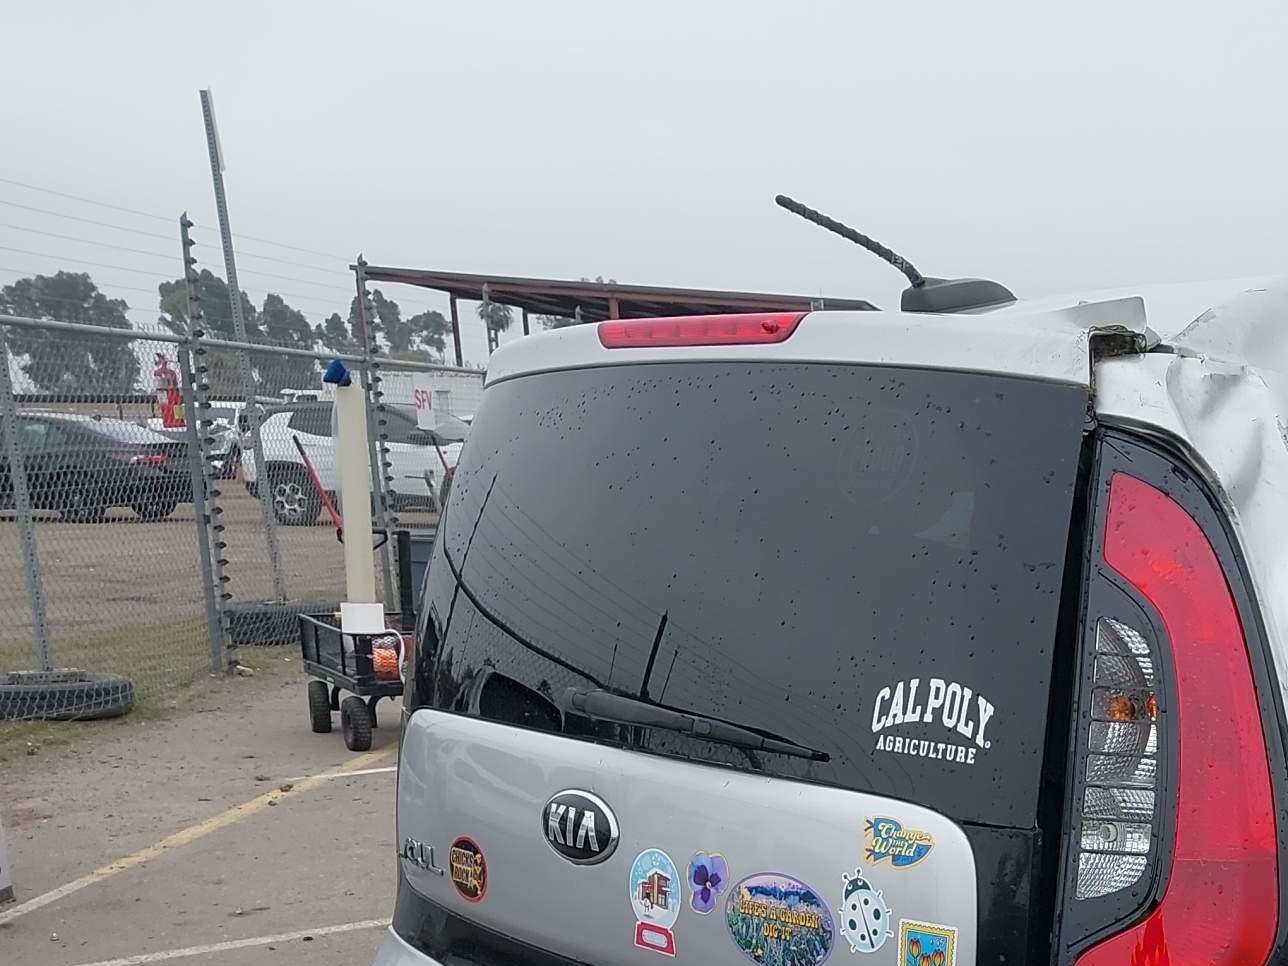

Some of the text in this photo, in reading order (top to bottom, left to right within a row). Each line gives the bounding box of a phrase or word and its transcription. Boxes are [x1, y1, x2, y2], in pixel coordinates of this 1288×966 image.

[415, 388, 432, 411] SFV
[871, 678, 995, 749] CAL POLY
[876, 734, 977, 765] AGRICULTURE
[548, 802, 600, 852] KIA
[878, 823, 931, 844] Change
[451, 848, 474, 867] CHICKS
[872, 837, 917, 857] World
[739, 899, 820, 929] LIFE'S A GARDEN
[763, 922, 793, 941] DIG IT
